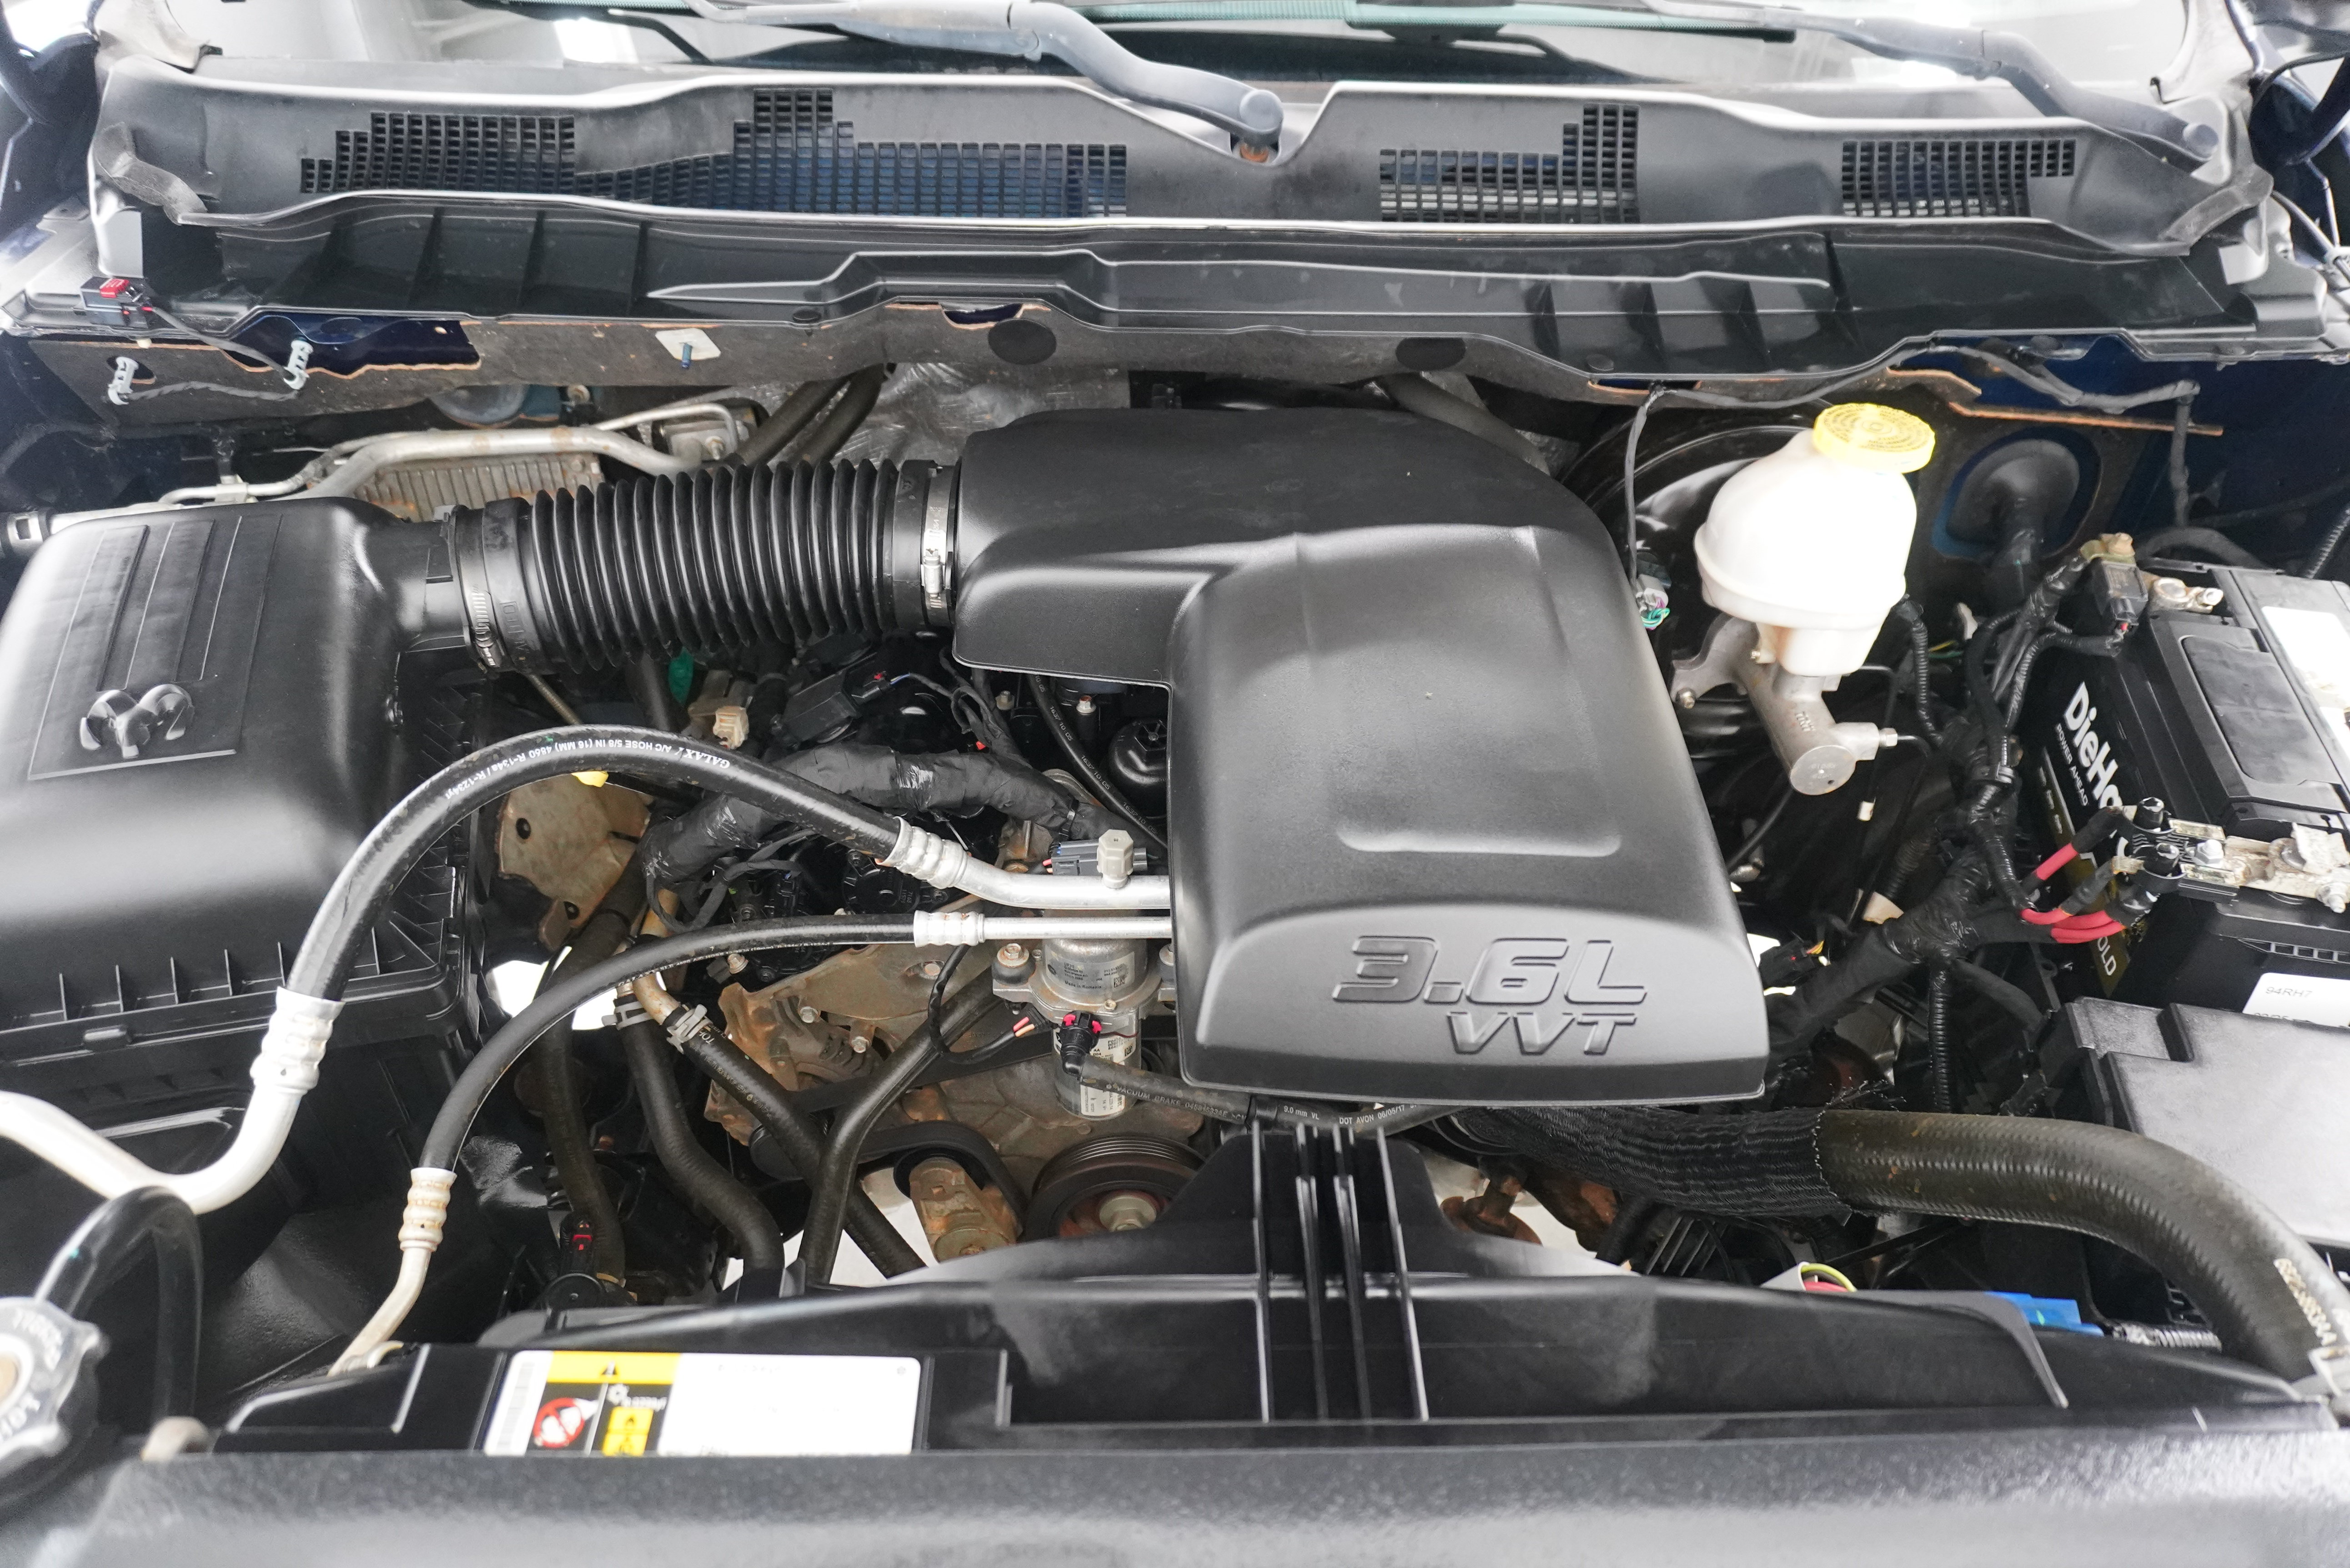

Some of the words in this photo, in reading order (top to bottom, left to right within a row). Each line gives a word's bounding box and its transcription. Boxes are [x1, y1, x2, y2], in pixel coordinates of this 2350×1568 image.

[1049, 705, 1061, 720] 1637
[554, 741, 577, 753] MM)
[577, 738, 593, 749] (16
[595, 739, 606, 748] IN
[608, 739, 623, 748] 5/8
[625, 739, 653, 752] HOSE
[655, 744, 672, 753] A/C
[528, 745, 552, 759] 4860
[674, 746, 731, 769] GALAXY
[491, 753, 527, 772] R-134a
[2055, 722, 2073, 765] POWER
[2069, 765, 2089, 807] AHEAD
[2064, 681, 2129, 857] DieHo
[1081, 755, 1095, 770] 1637
[1094, 770, 1111, 790] 10:05
[2097, 936, 2117, 976] OLD
[1331, 935, 1647, 1005] 3.6L
[2265, 986, 2313, 998] 94RH7
[1446, 1011, 1637, 1056] VVT
[1117, 1086, 1150, 1100] VACUUM
[1155, 1096, 1181, 1107] BRAKE
[1283, 1105, 1294, 1114] 9.0
[1311, 1112, 1320, 1121] VL
[1356, 1114, 1374, 1124] AVON
